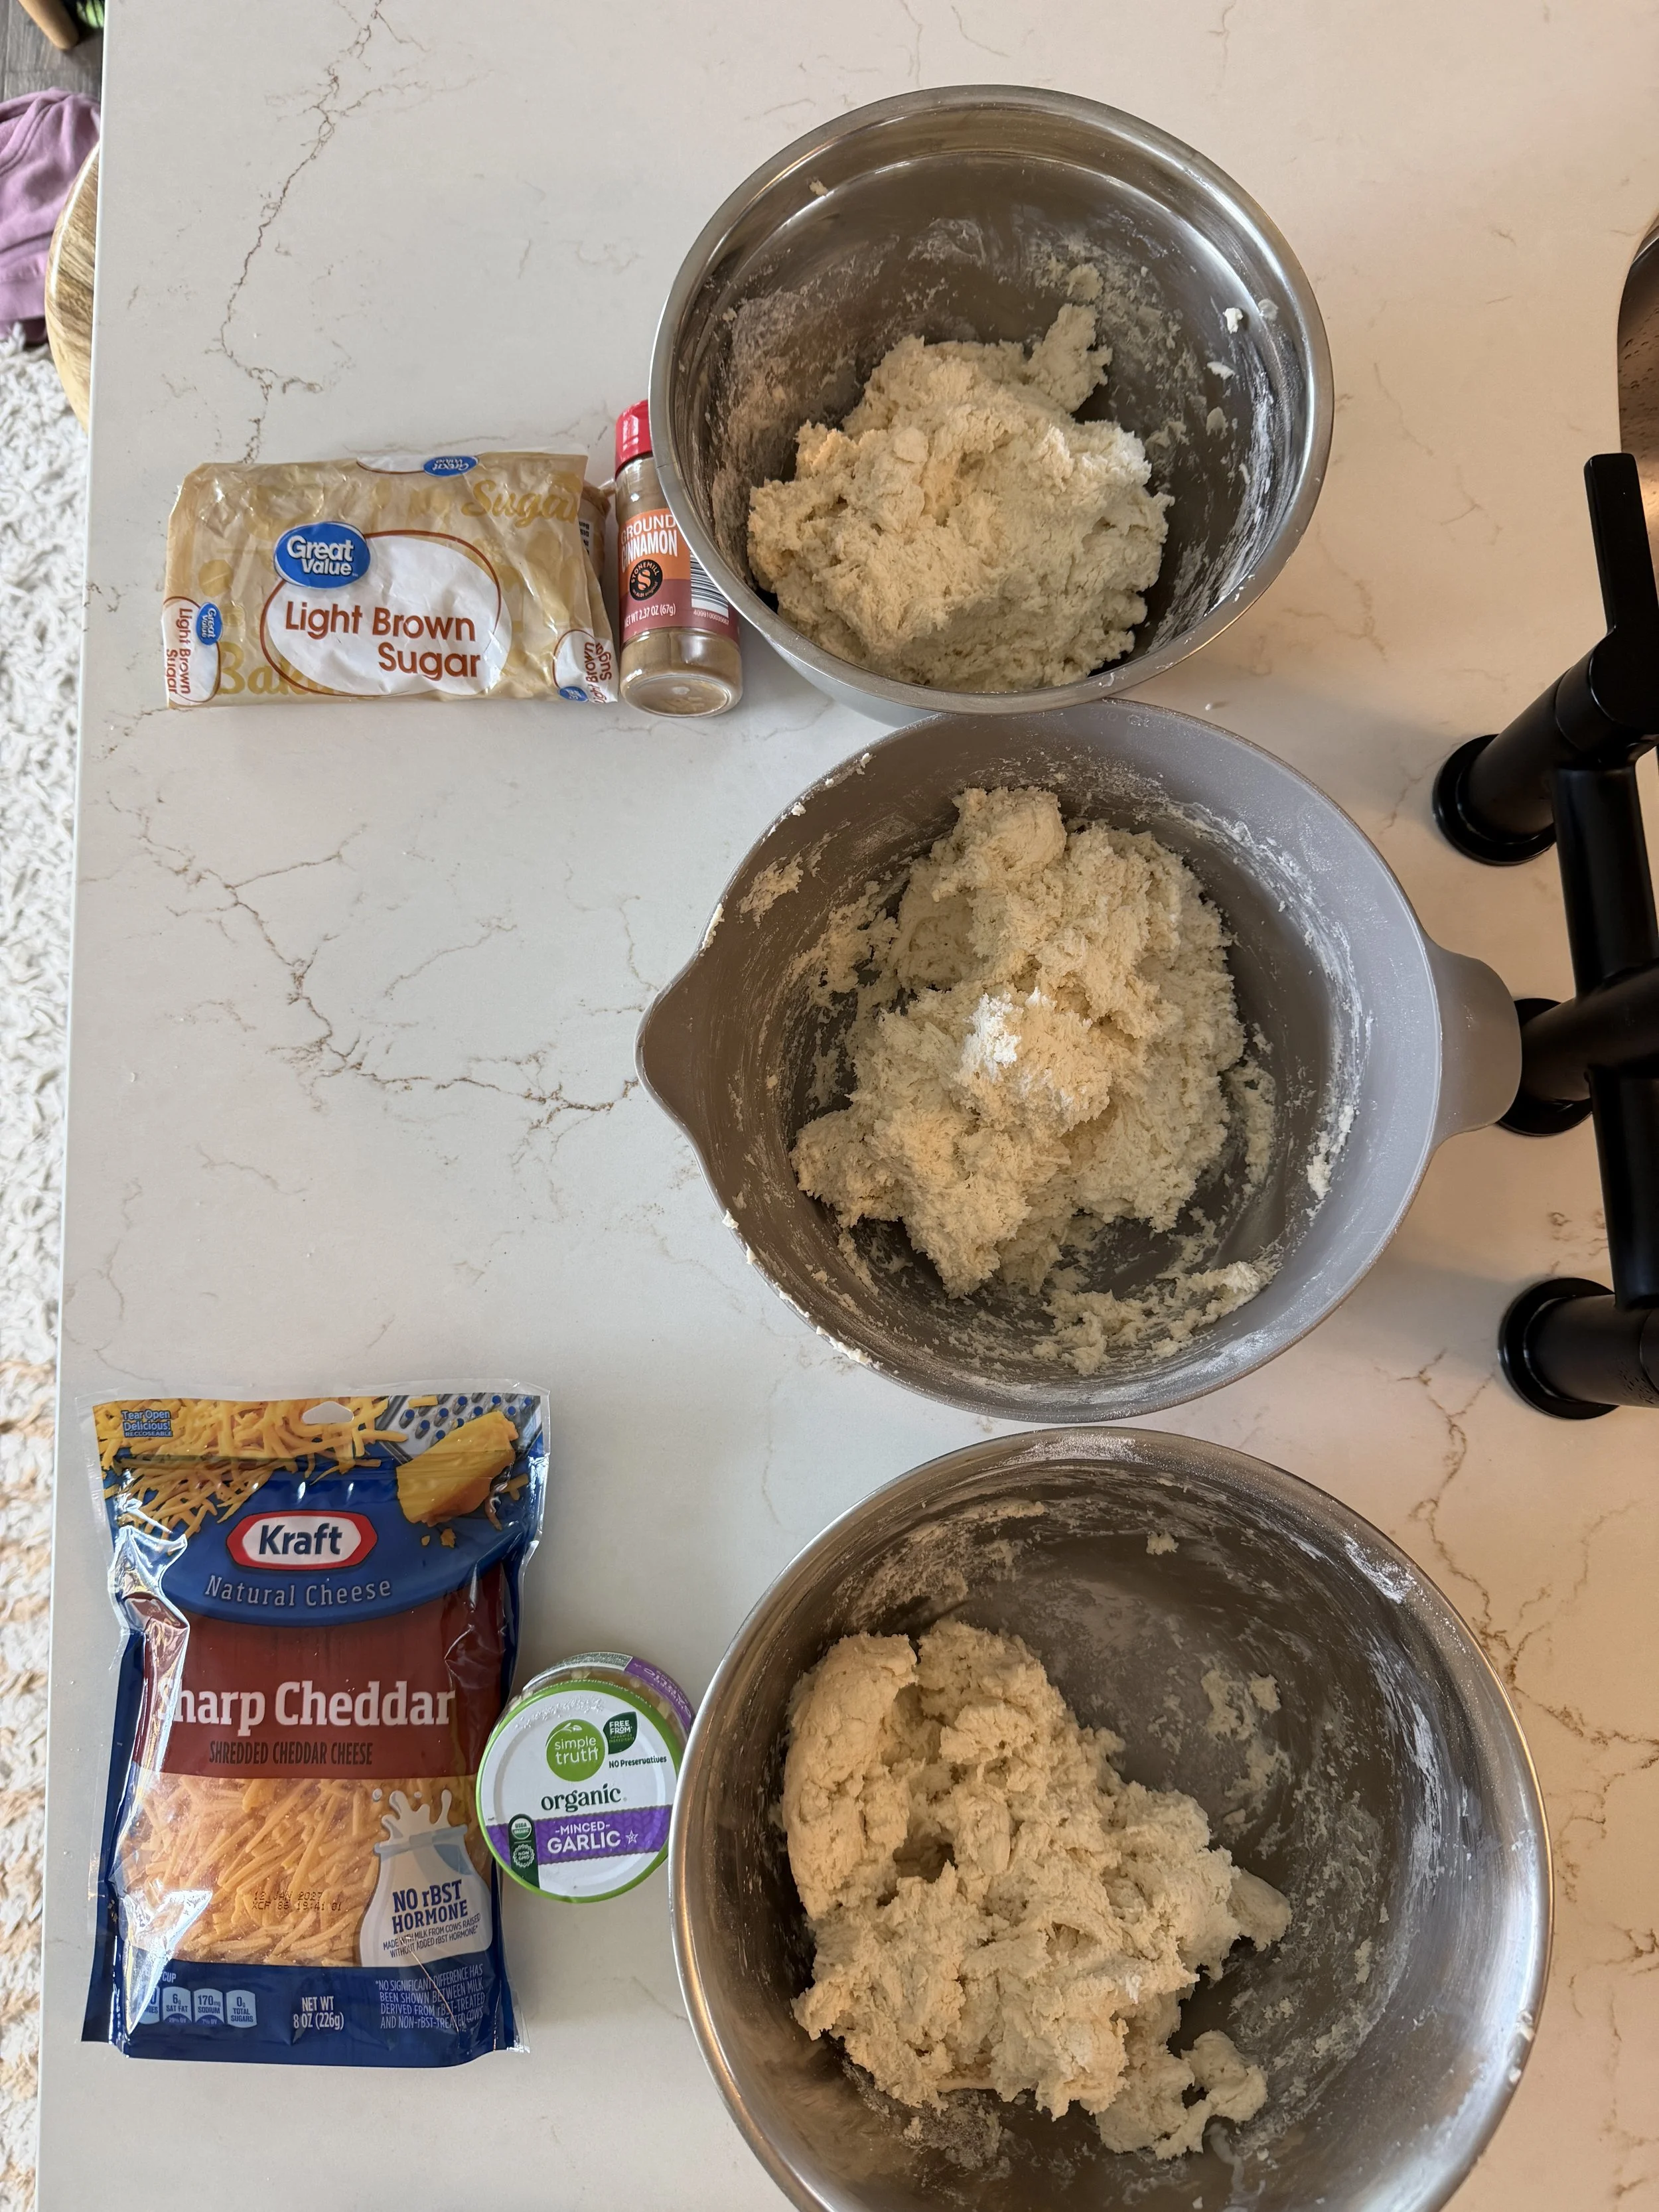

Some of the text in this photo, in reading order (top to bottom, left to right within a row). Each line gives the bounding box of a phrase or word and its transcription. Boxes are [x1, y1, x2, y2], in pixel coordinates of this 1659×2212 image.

[620, 514, 678, 545] GROUND
[287, 535, 354, 562] Great
[622, 529, 678, 573] CINNAMON
[301, 557, 352, 577] Value
[630, 561, 660, 583] STONEMILL
[207, 608, 216, 638] Great
[285, 601, 476, 642] Light Brown
[631, 613, 639, 623] WT
[639, 607, 650, 619] 2.37
[651, 605, 659, 617] OZ
[660, 604, 676, 617] (67g)
[175, 608, 193, 695] Light Brown
[378, 642, 481, 682] Sugar
[583, 642, 599, 683] Brown
[166, 648, 179, 695] Sugar
[121, 1409, 171, 1420] Tear Open
[123, 1420, 171, 1431] Delicious!
[259, 1522, 343, 1555] Kraft
[204, 1574, 392, 1607] Natural Cheese
[275, 1680, 456, 1726] Cheddar
[555, 1736, 597, 1751] simple
[610, 1726, 632, 1735] FROM
[209, 1741, 374, 1765] SHREDDED CHEDDAR CHEESE
[555, 1747, 599, 1765] truth
[609, 1755, 668, 1769] NO Preservatives
[541, 1783, 622, 1812] organic
[547, 1830, 621, 1854] GARLIC
[392, 1879, 463, 1913] NO rBST
[392, 1899, 468, 1935] HORMONE
[383, 1939, 399, 1951] MADE
[414, 1930, 428, 1941] MILK
[428, 1925, 445, 1937] FROM
[445, 1921, 462, 1933] COWS
[463, 1913, 481, 1929] RAISED
[390, 1944, 416, 1958] WITHOUT
[416, 1937, 435, 1951] ADDED
[435, 1934, 449, 1945] rBST
[162, 1971, 177, 1983] CUP
[380, 1977, 484, 2004] BEEN SHOWN BETWEEN MILK
[390, 1977, 432, 1992] SIGNIFICANT
[433, 1967, 469, 1988] DIFFERENCE
[469, 1964, 484, 1978] HAS
[301, 1996, 334, 2012] NET WT
[380, 2003, 412, 2015] DERIVED
[414, 2004, 435, 2016] FROM
[380, 2016, 397, 2029] AND
[466, 2006, 484, 2023] COWS
[293, 2012, 344, 2031] 8 OZ (226g)
